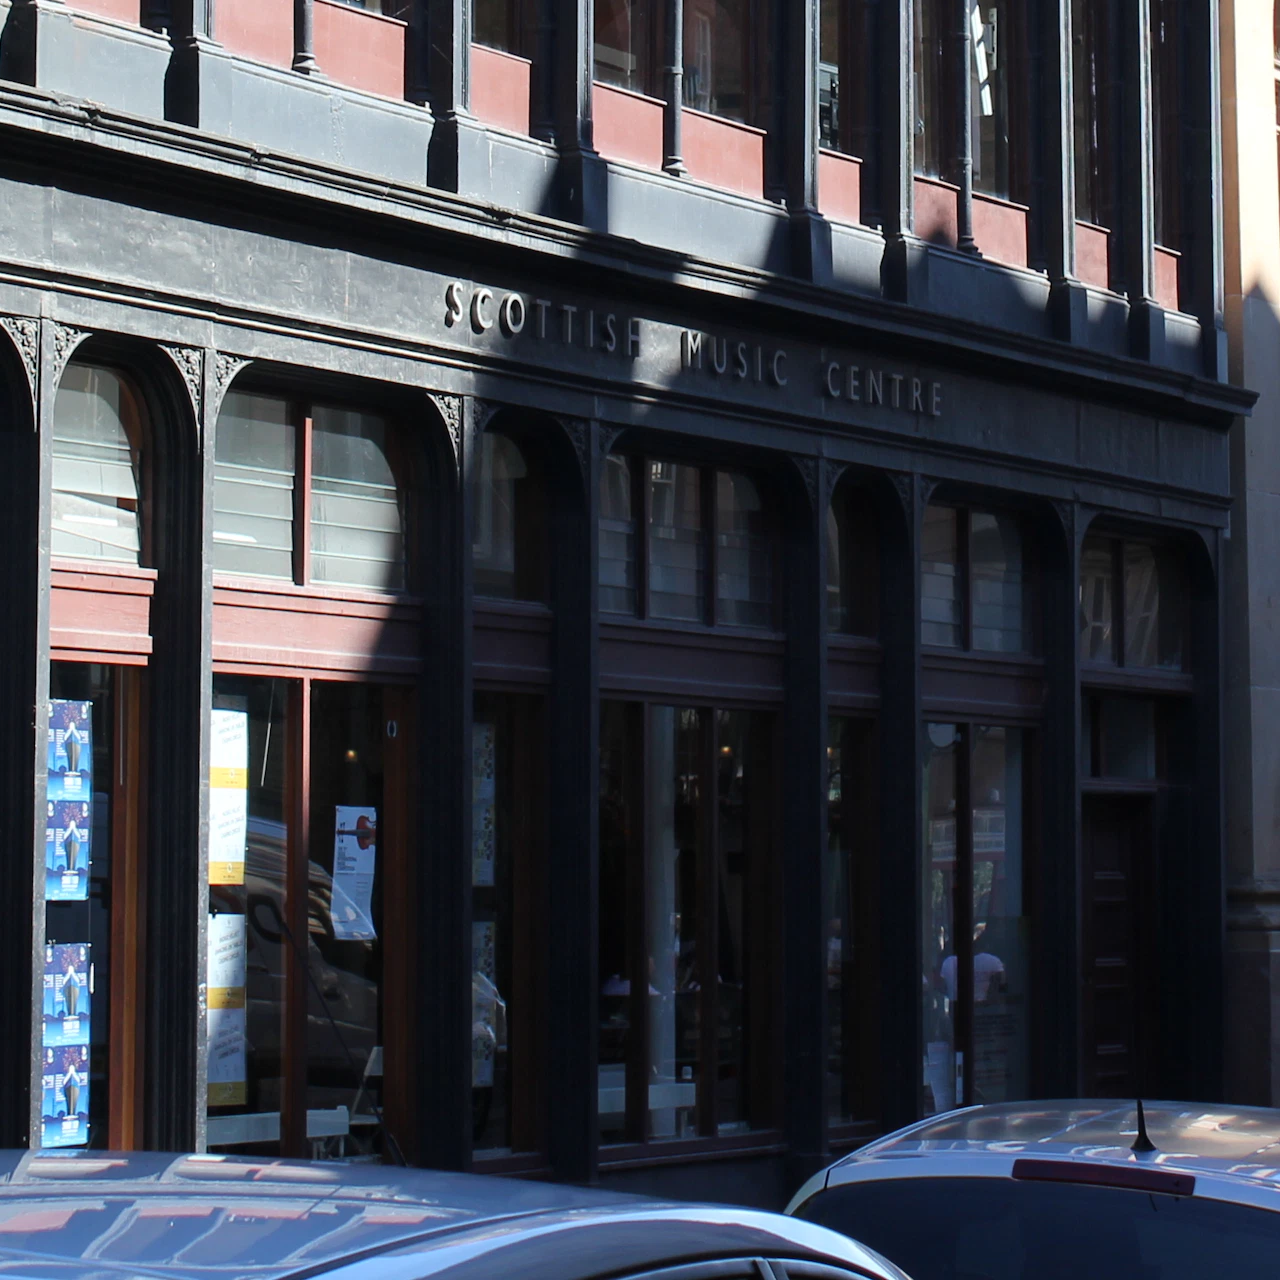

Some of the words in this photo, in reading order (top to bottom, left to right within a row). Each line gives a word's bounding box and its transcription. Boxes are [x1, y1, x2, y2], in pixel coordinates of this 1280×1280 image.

[445, 281, 641, 358] SCOTTISH
[681, 330, 789, 388] MUSIC
[824, 360, 944, 418] CENTRE
